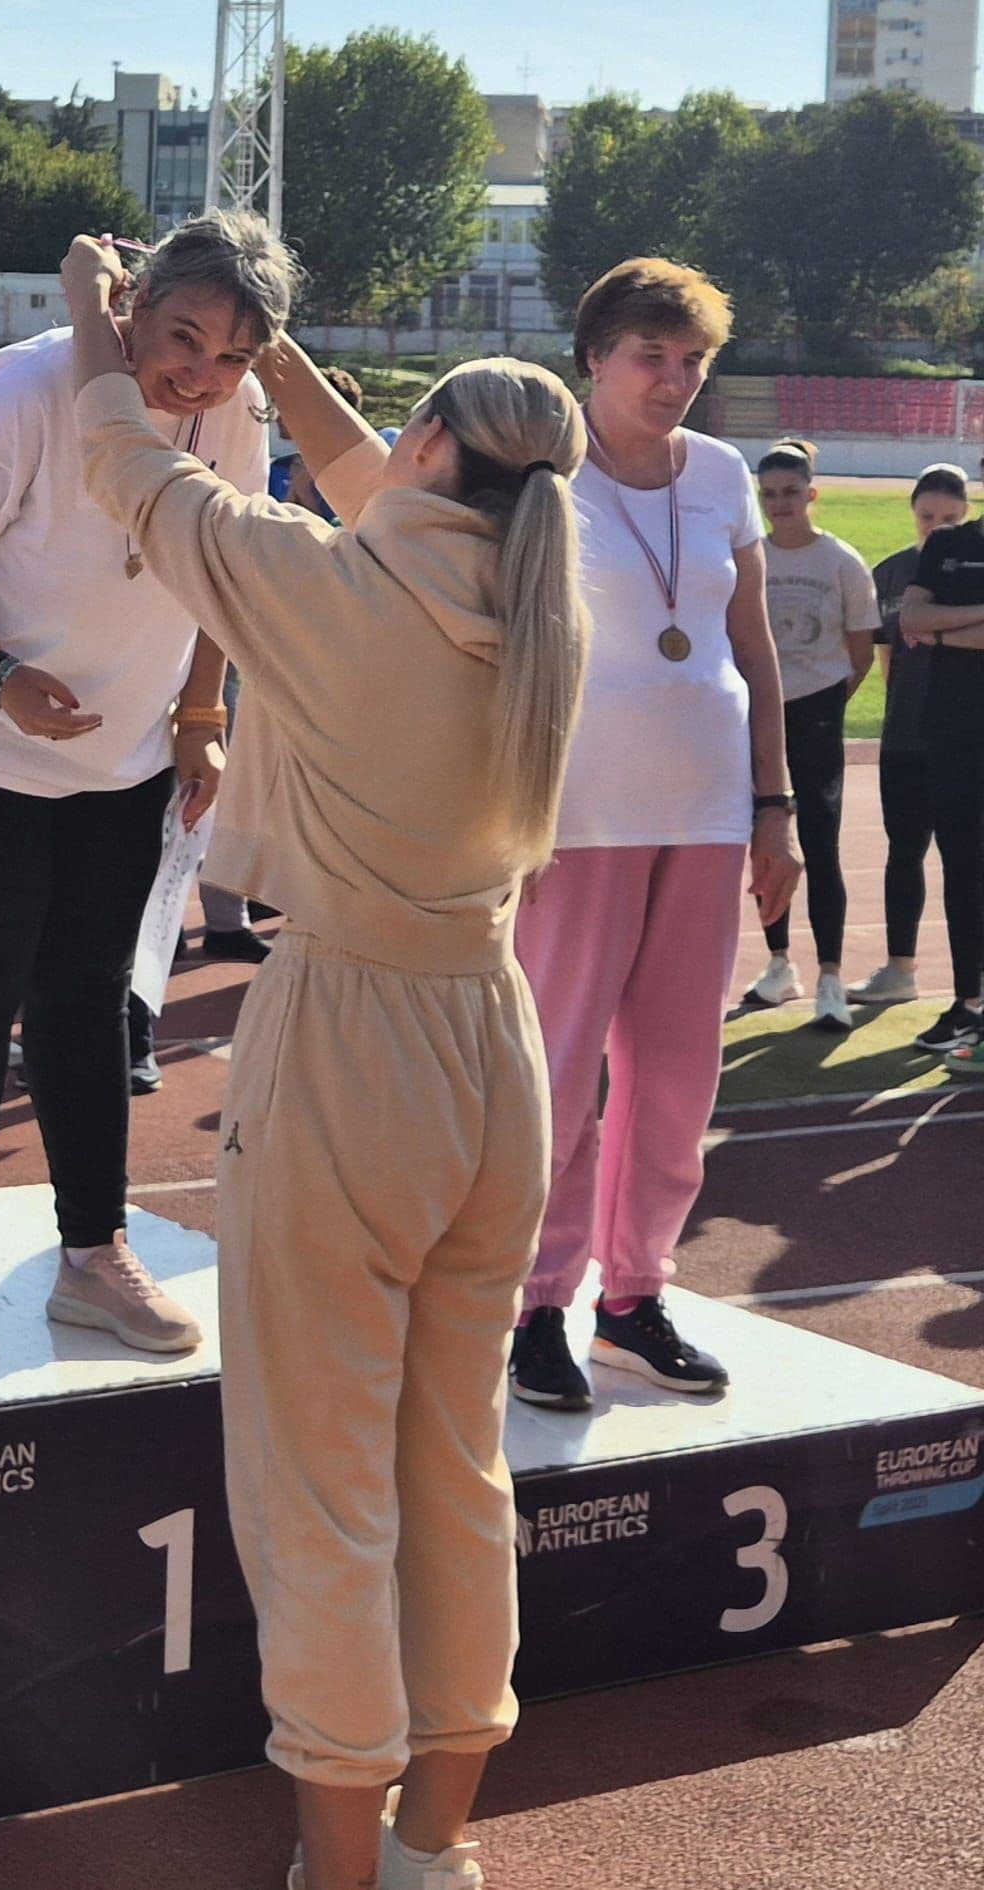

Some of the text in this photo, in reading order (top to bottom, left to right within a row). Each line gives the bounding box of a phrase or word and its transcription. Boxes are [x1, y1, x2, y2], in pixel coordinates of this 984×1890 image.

[876, 1436, 980, 1473] EUROPEAN
[537, 1490, 650, 1530] EUROPEAN
[536, 1513, 649, 1553] ATHLETICS
[718, 1485, 790, 1633] 3
[137, 1507, 195, 1675] 1
